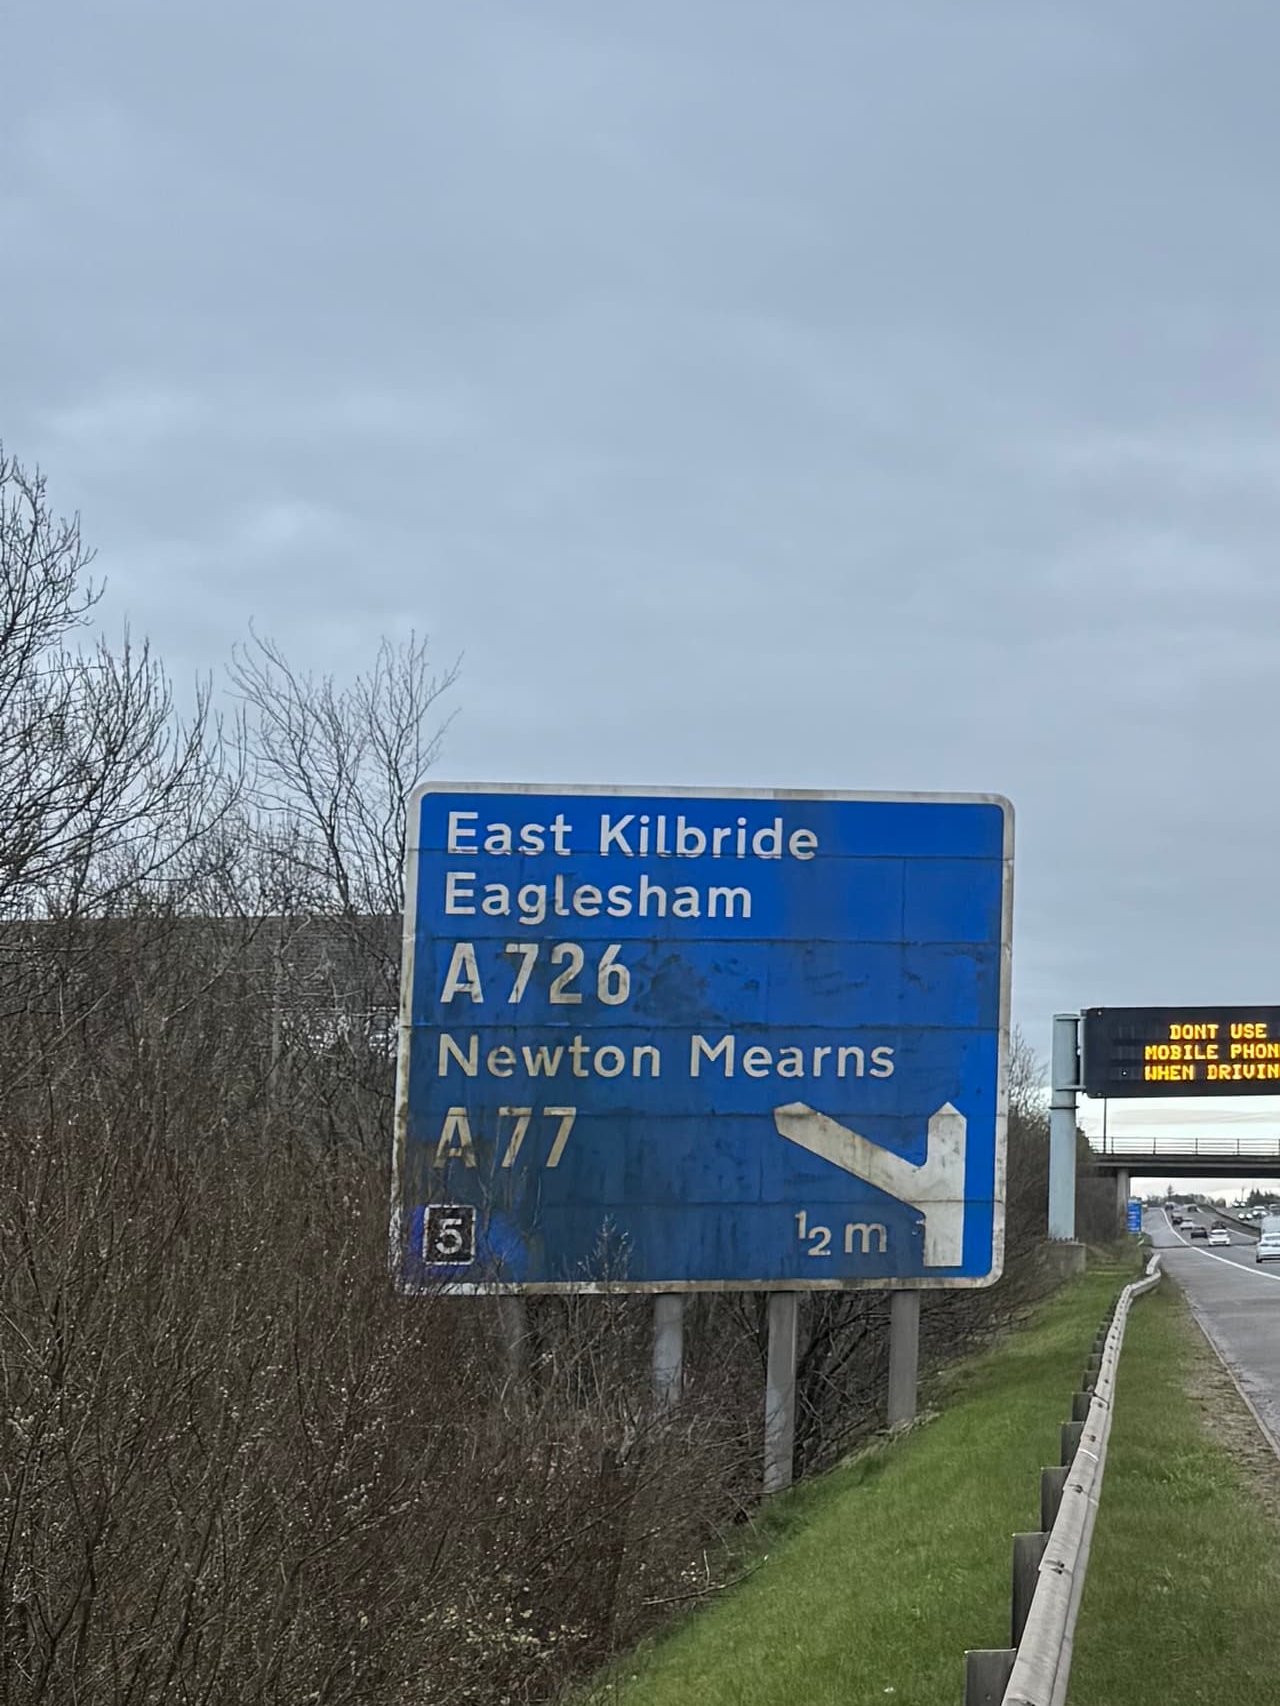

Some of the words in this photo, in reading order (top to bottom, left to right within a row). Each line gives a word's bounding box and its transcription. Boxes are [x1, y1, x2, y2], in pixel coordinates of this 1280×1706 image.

[447, 811, 573, 856] East
[600, 814, 819, 860] Kilbride
[445, 872, 752, 925] Eaglesham
[1169, 1024, 1219, 1040] DONT
[1230, 1023, 1267, 1039] USE
[438, 1033, 660, 1078] Newton
[690, 1034, 895, 1078] Mearns
[1144, 1044, 1219, 1060] MOBILE
[1144, 1065, 1195, 1080] WHEN
[435, 1218, 462, 1254] 5
[845, 1222, 887, 1253] m
